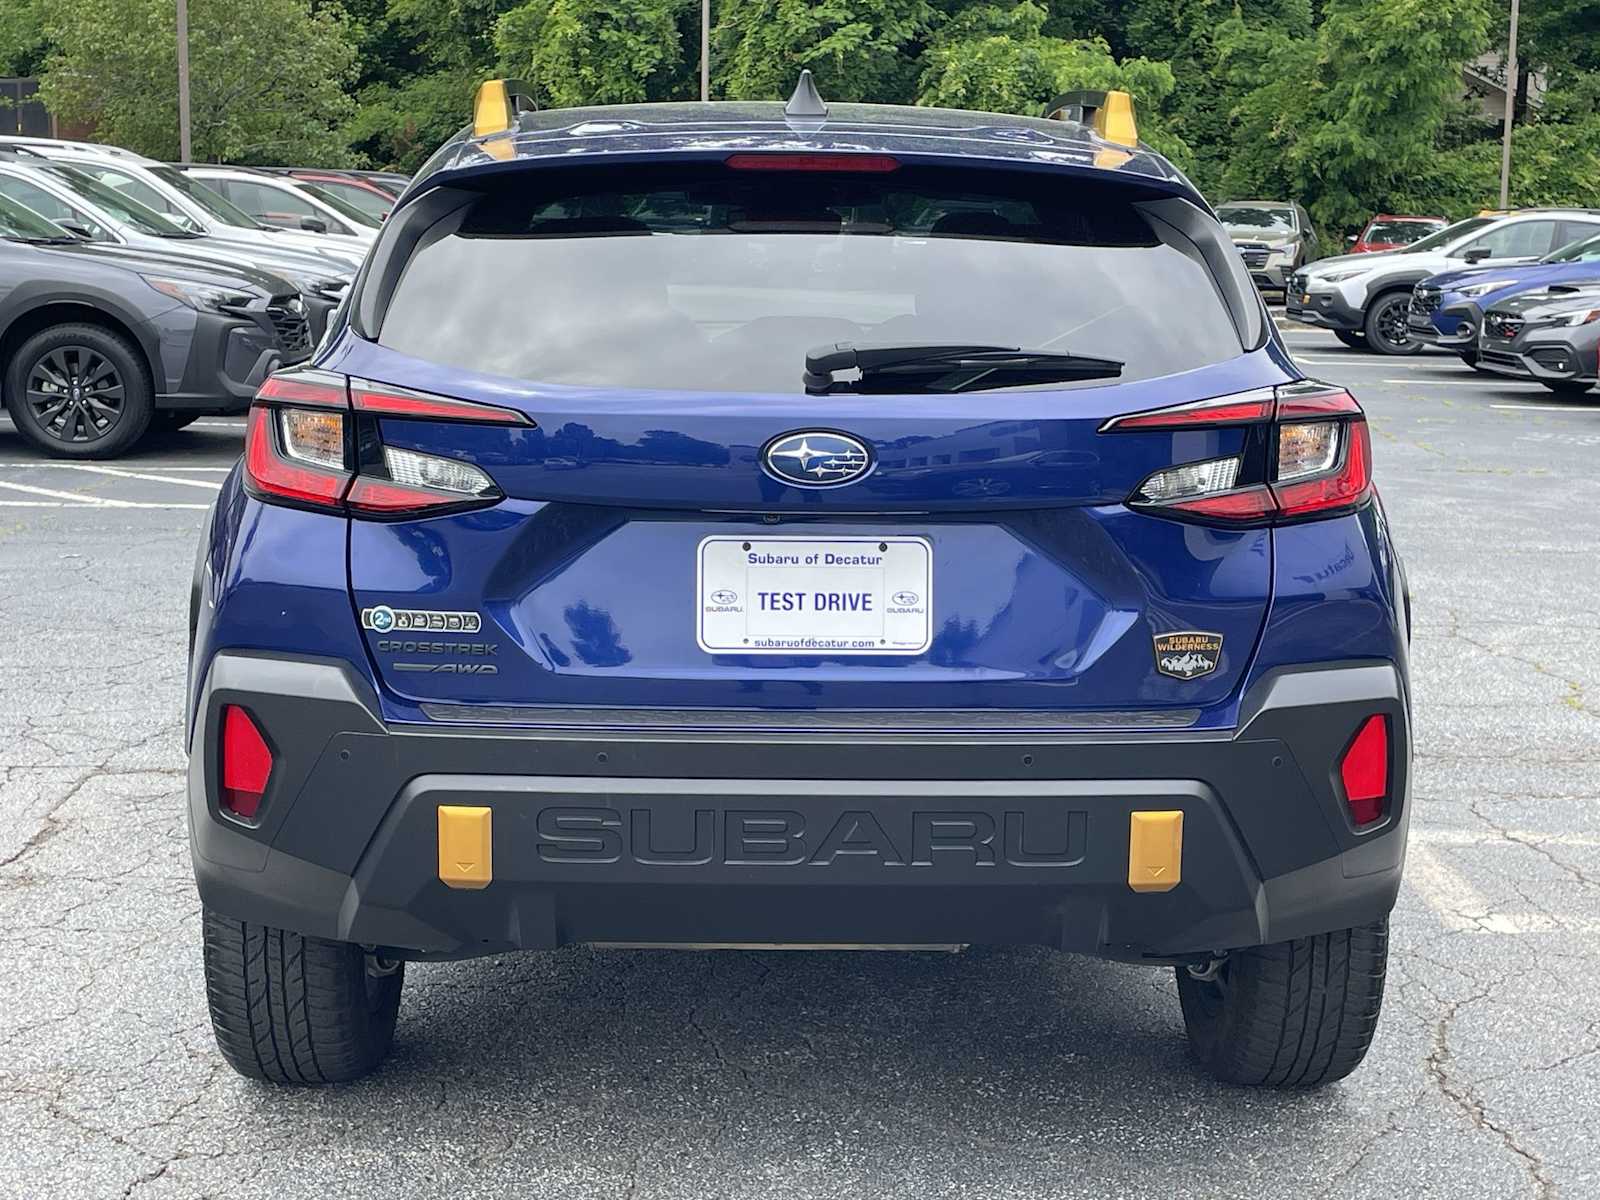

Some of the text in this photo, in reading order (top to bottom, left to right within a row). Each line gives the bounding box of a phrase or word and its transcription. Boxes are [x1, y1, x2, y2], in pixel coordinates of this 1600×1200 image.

[748, 553, 883, 565] Subaru of Decatur
[757, 592, 873, 611] TEST DRIVE
[1168, 636, 1208, 644] SUBARU
[377, 640, 498, 656] CROSSTREK
[1157, 643, 1219, 651] WILDERNESS
[432, 664, 498, 674] AWD
[536, 807, 1089, 867] SUBARU
